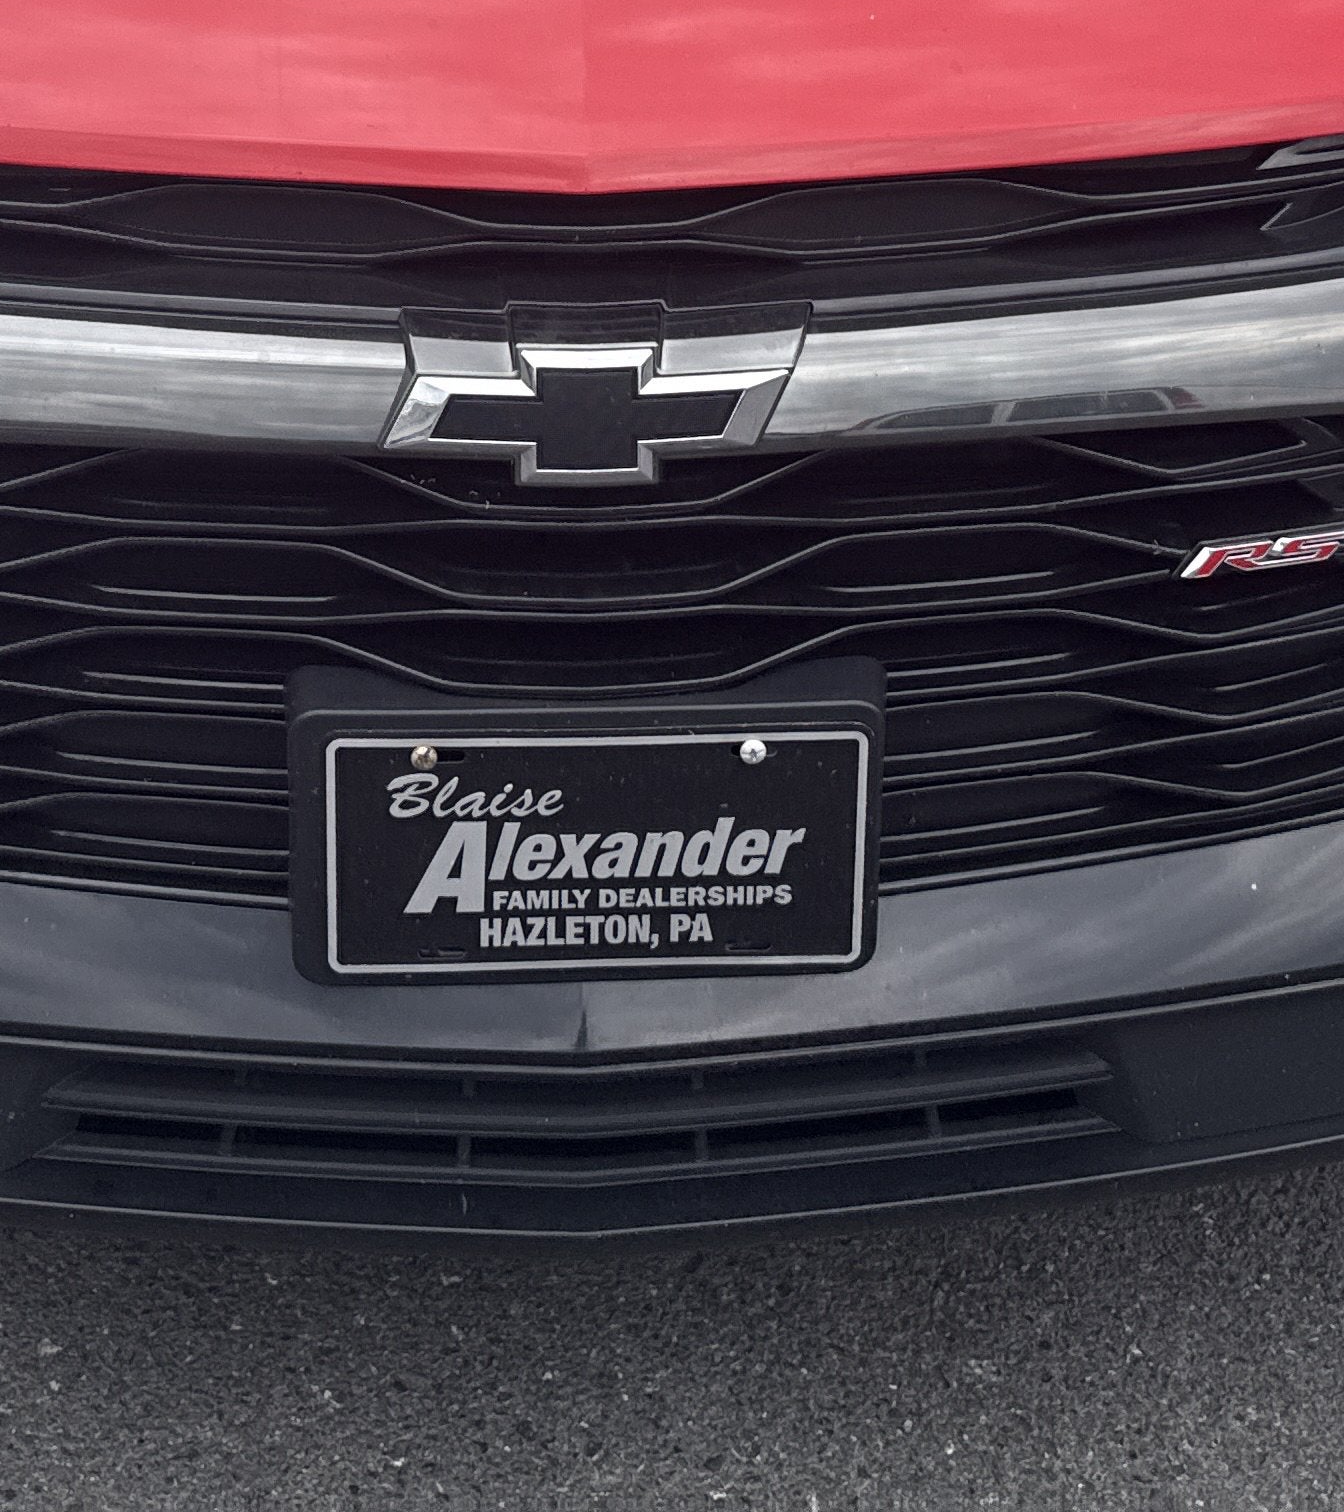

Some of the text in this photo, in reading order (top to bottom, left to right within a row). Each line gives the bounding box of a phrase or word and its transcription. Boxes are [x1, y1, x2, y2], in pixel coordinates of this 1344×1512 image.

[386, 772, 565, 819] Blaise
[403, 816, 806, 914] Alexander
[492, 883, 793, 911] FAMILY DEALERSHIPS
[479, 912, 714, 949] HAZLETON, PA
